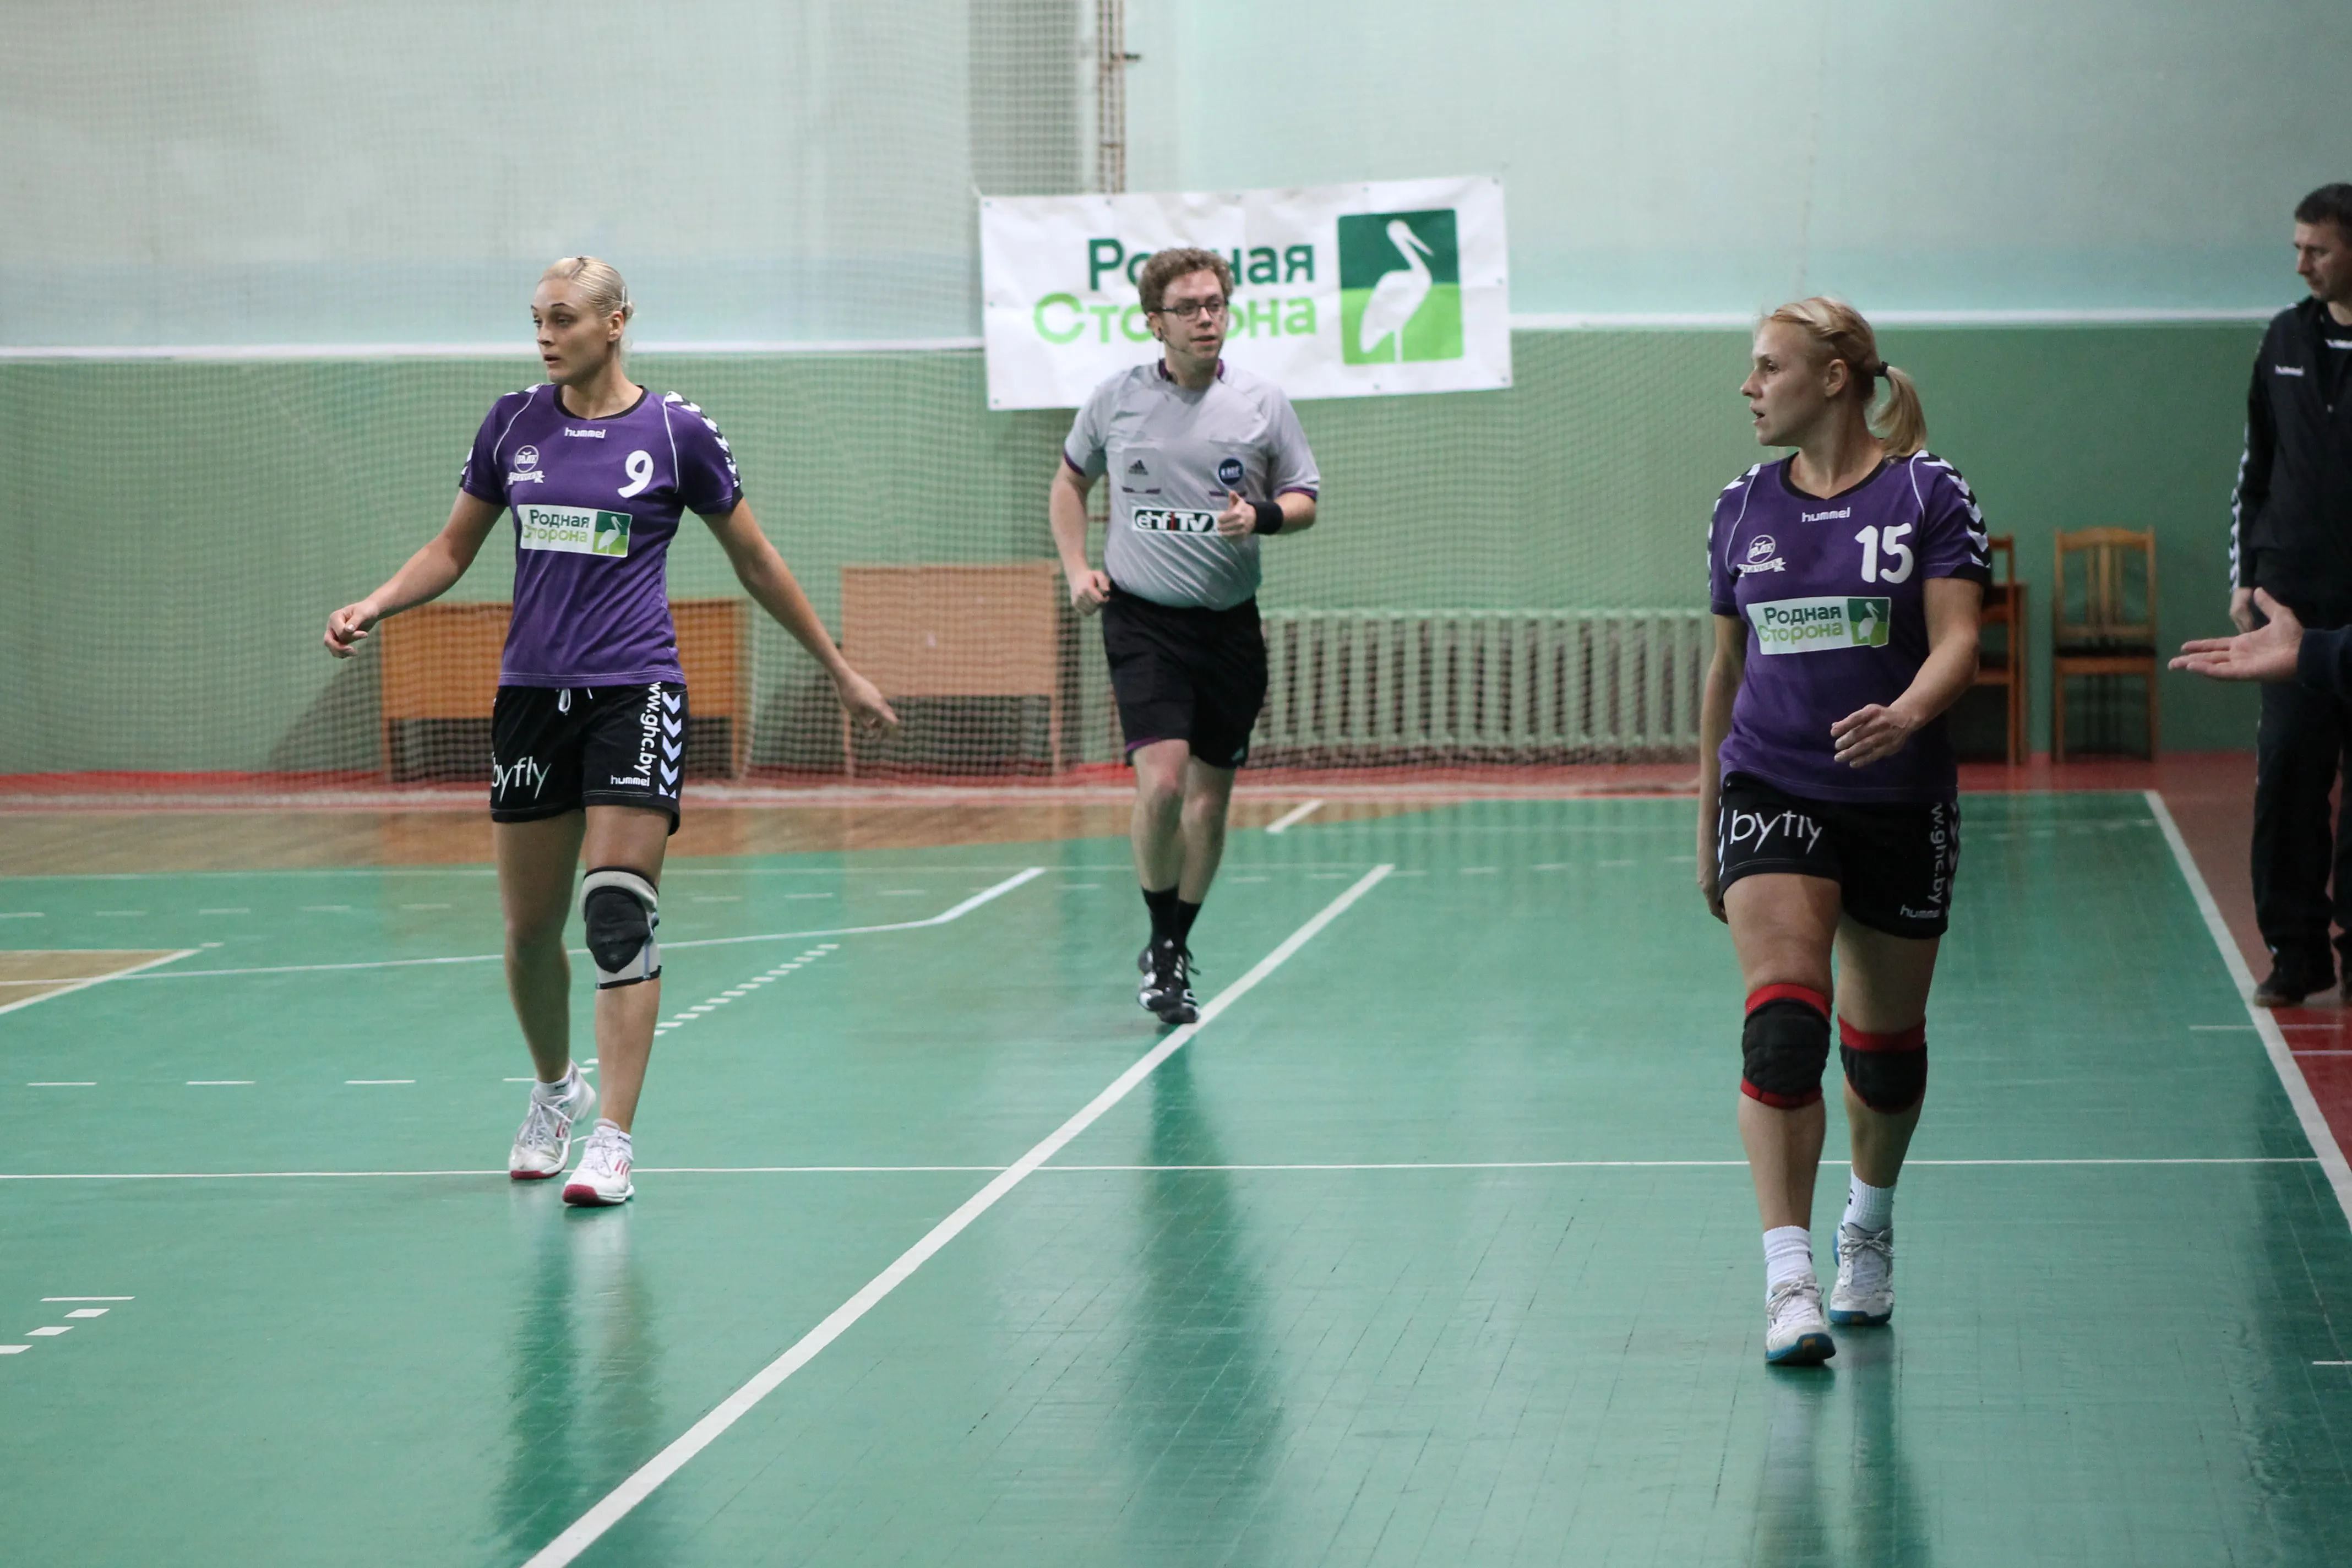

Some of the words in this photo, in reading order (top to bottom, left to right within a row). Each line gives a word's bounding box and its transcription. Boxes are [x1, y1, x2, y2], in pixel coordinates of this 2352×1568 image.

[1087, 238, 1315, 291] Роная
[1033, 292, 1316, 345] Стоона
[564, 427, 606, 439] hummel
[618, 450, 654, 498] 9
[530, 509, 590, 527] Родная
[1801, 507, 1850, 522] hummel
[522, 524, 588, 543] Сторона
[1854, 522, 1914, 584] 15
[1764, 606, 1842, 625] Родная
[1758, 622, 1844, 645] Сторона
[611, 775, 650, 787] hummel
